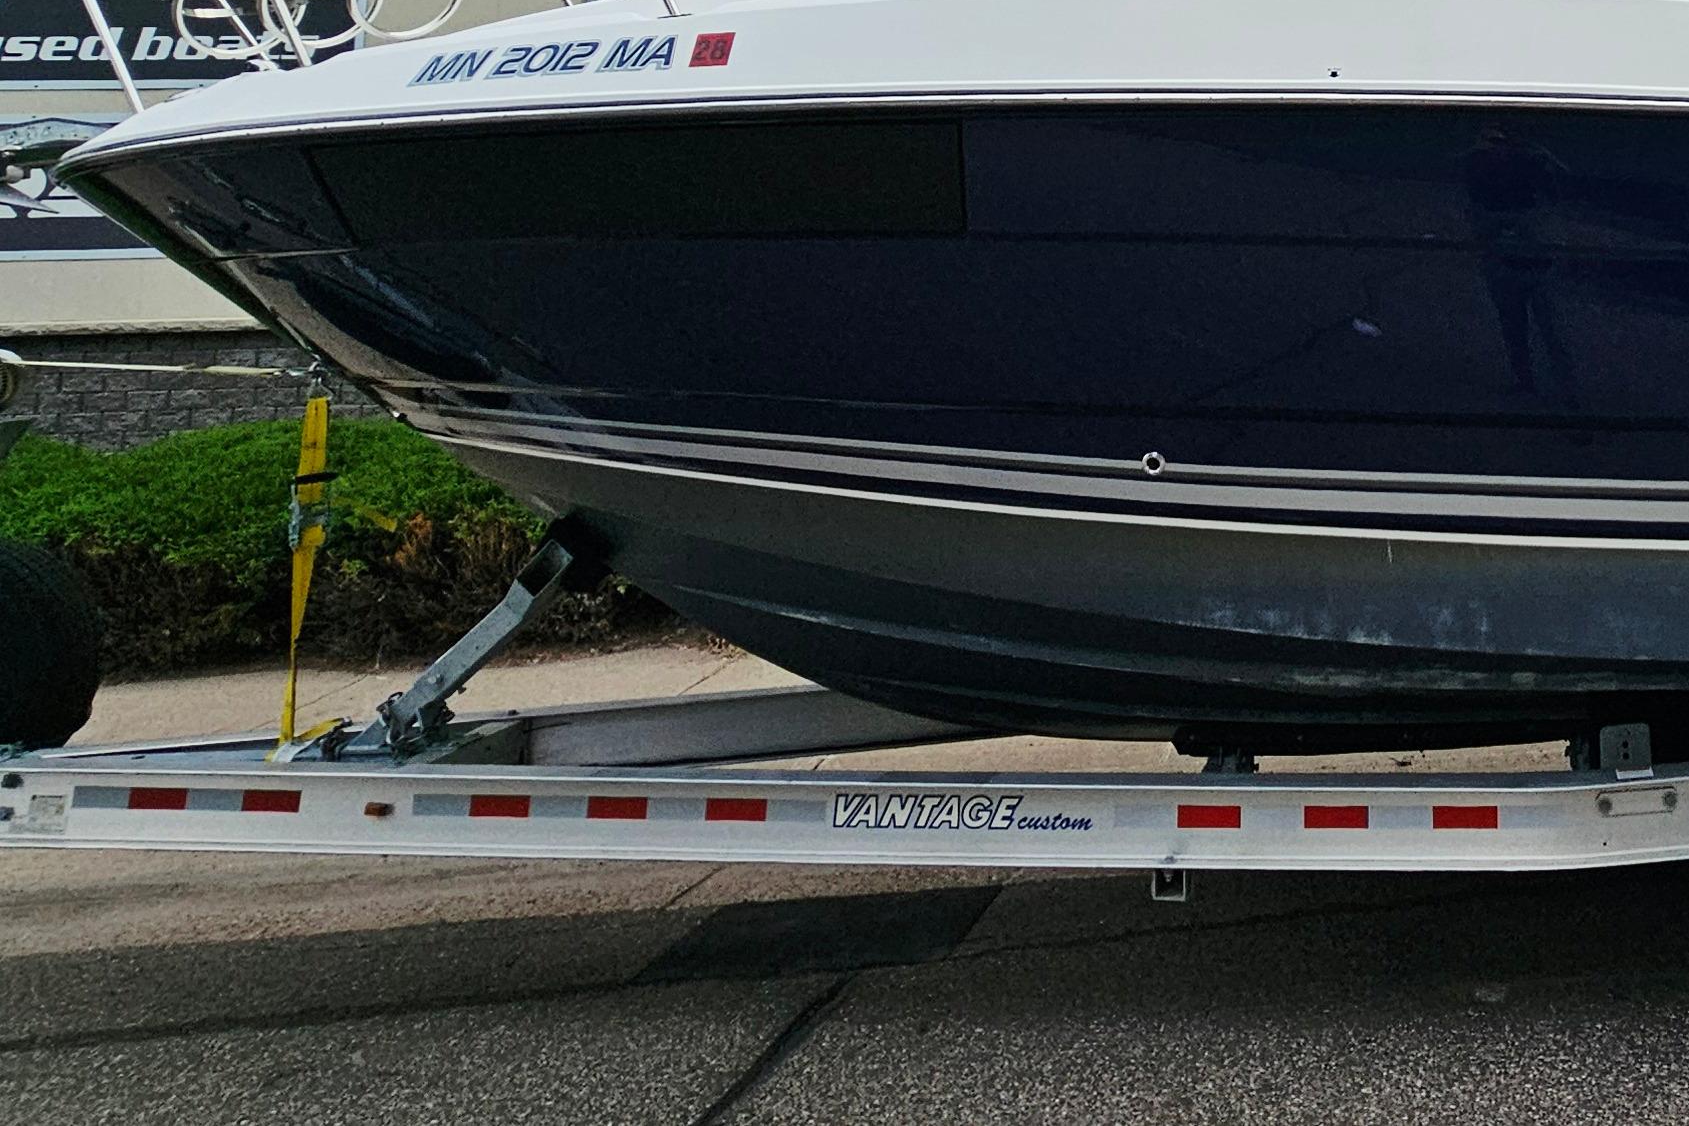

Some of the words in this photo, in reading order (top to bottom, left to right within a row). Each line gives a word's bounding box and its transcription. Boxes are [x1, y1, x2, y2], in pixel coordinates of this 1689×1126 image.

[410, 49, 494, 85] MN
[487, 41, 601, 77] 2012
[598, 35, 677, 71] MA
[833, 793, 1023, 829] VANTAGE
[1017, 812, 1093, 831] custom
